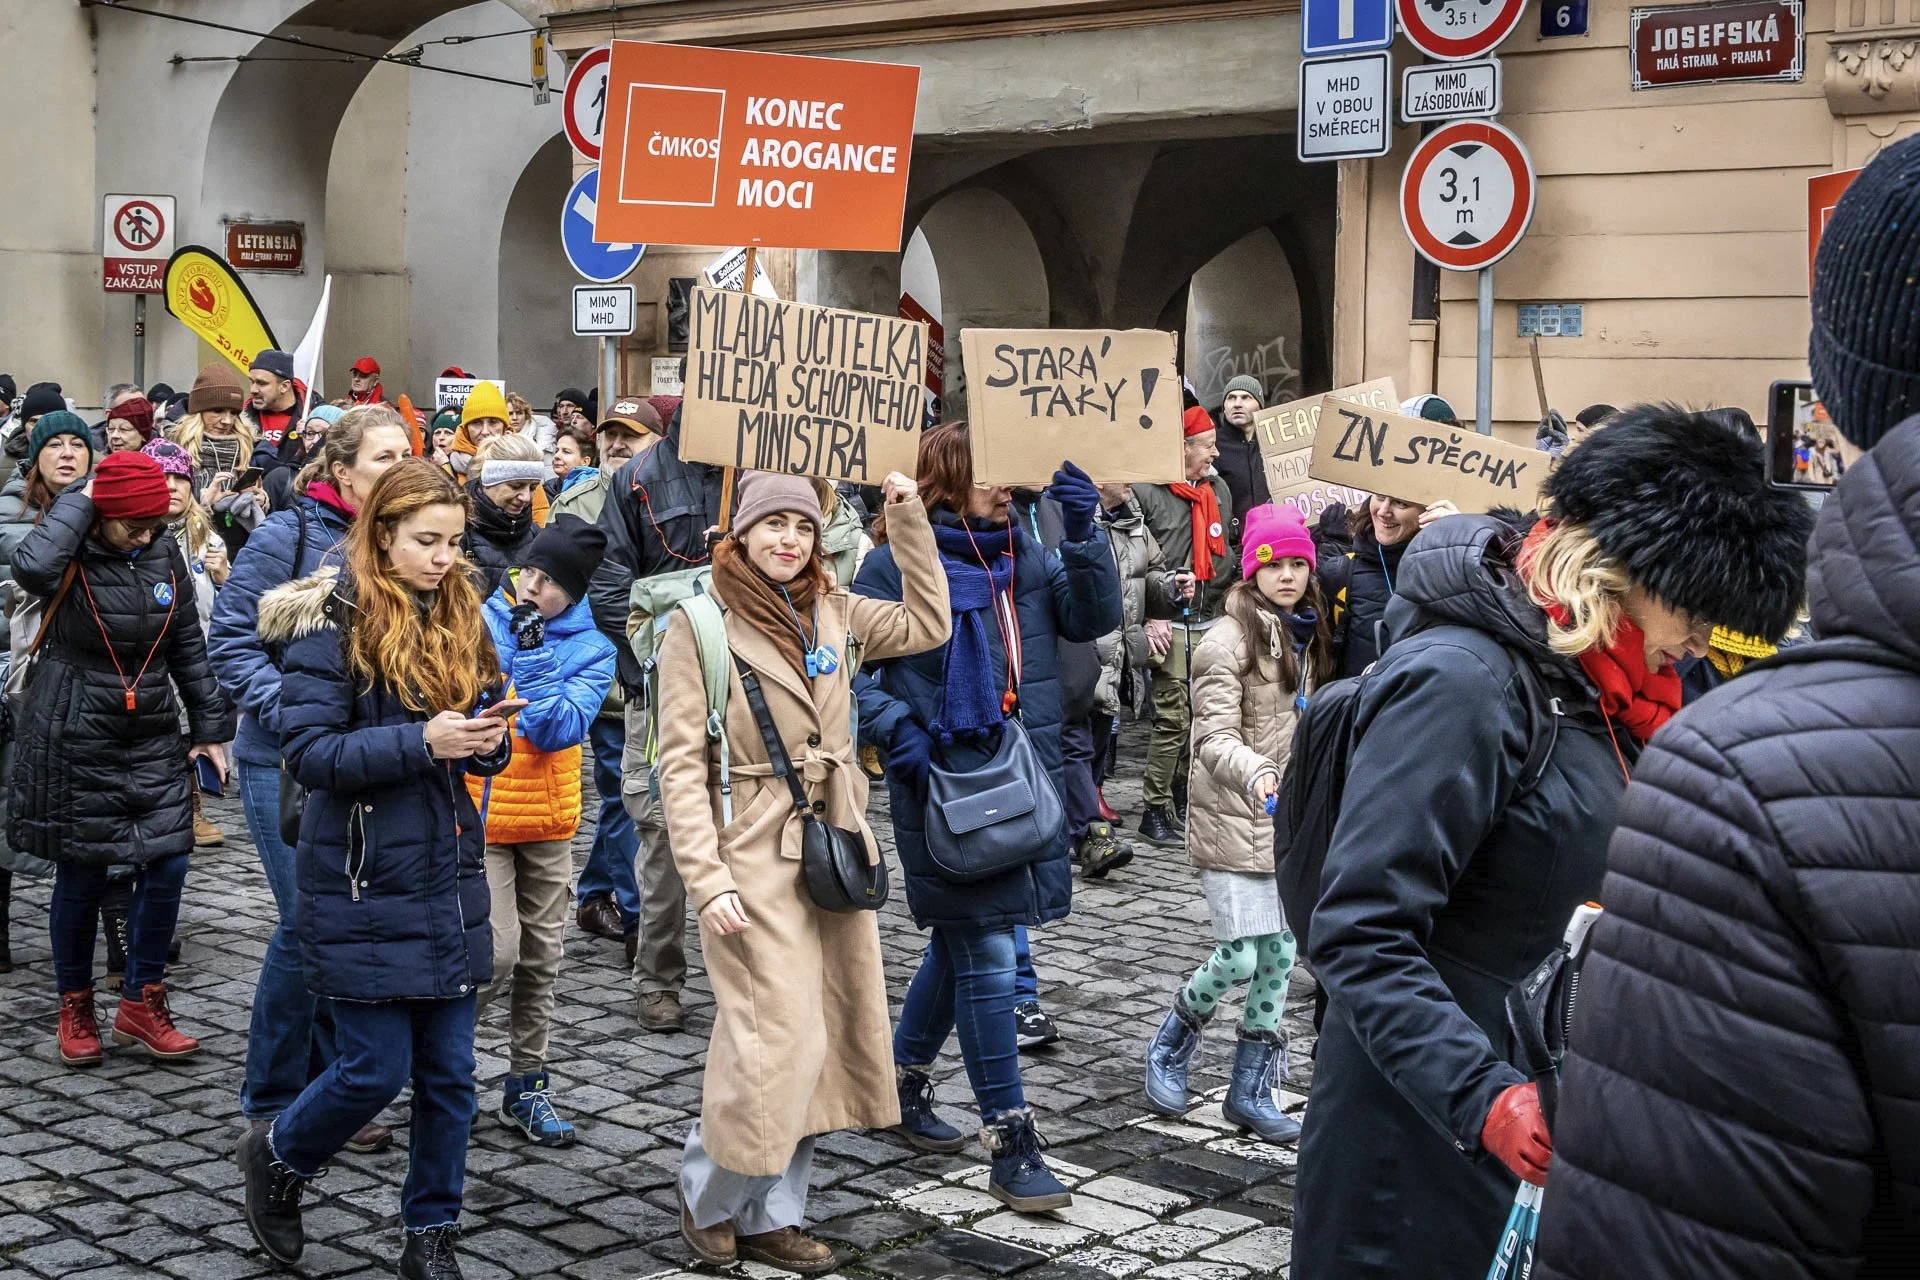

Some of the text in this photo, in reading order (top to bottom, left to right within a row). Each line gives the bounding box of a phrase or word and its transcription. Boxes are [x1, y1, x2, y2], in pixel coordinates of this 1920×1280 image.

[1445, 8, 1477, 26] 3,5 t
[1556, 5, 1570, 28] 6
[1651, 13, 1780, 52] JOSEFSKÁ
[534, 46, 543, 66] 10
[1656, 53, 1680, 71] MALÁ
[1682, 53, 1719, 69] STRANA
[1731, 50, 1764, 65] PRAHA
[1765, 49, 1771, 62] 1
[1327, 76, 1360, 94] MHD
[1435, 73, 1466, 92] MIMO
[1316, 97, 1373, 115] V OBOU
[1414, 86, 1489, 112] ZÁSOBOVÁNÍ
[745, 96, 845, 131] KONEC
[1308, 117, 1380, 139] SMĚRECH
[648, 131, 719, 159] ČMKOS
[740, 137, 897, 174] AROGANCE
[736, 178, 814, 209] MOCI
[1439, 167, 1480, 204] 3,1
[1456, 208, 1474, 223] m
[237, 233, 297, 250] LETENSKÁ
[119, 263, 158, 275] VSTUP
[105, 277, 163, 289] ZAKÁZÁN
[590, 296, 617, 308] MIMO
[591, 312, 614, 325] MHD
[696, 289, 922, 384] MLADÁ UČITELKA
[985, 335, 1112, 388] STARÁ
[697, 350, 920, 432] HLEDÁ SCHOPNÉHO
[1020, 377, 1127, 422] TAKY
[735, 408, 868, 481] MINISTRA
[1332, 408, 1528, 490] ZN. SPĚCHÁ
